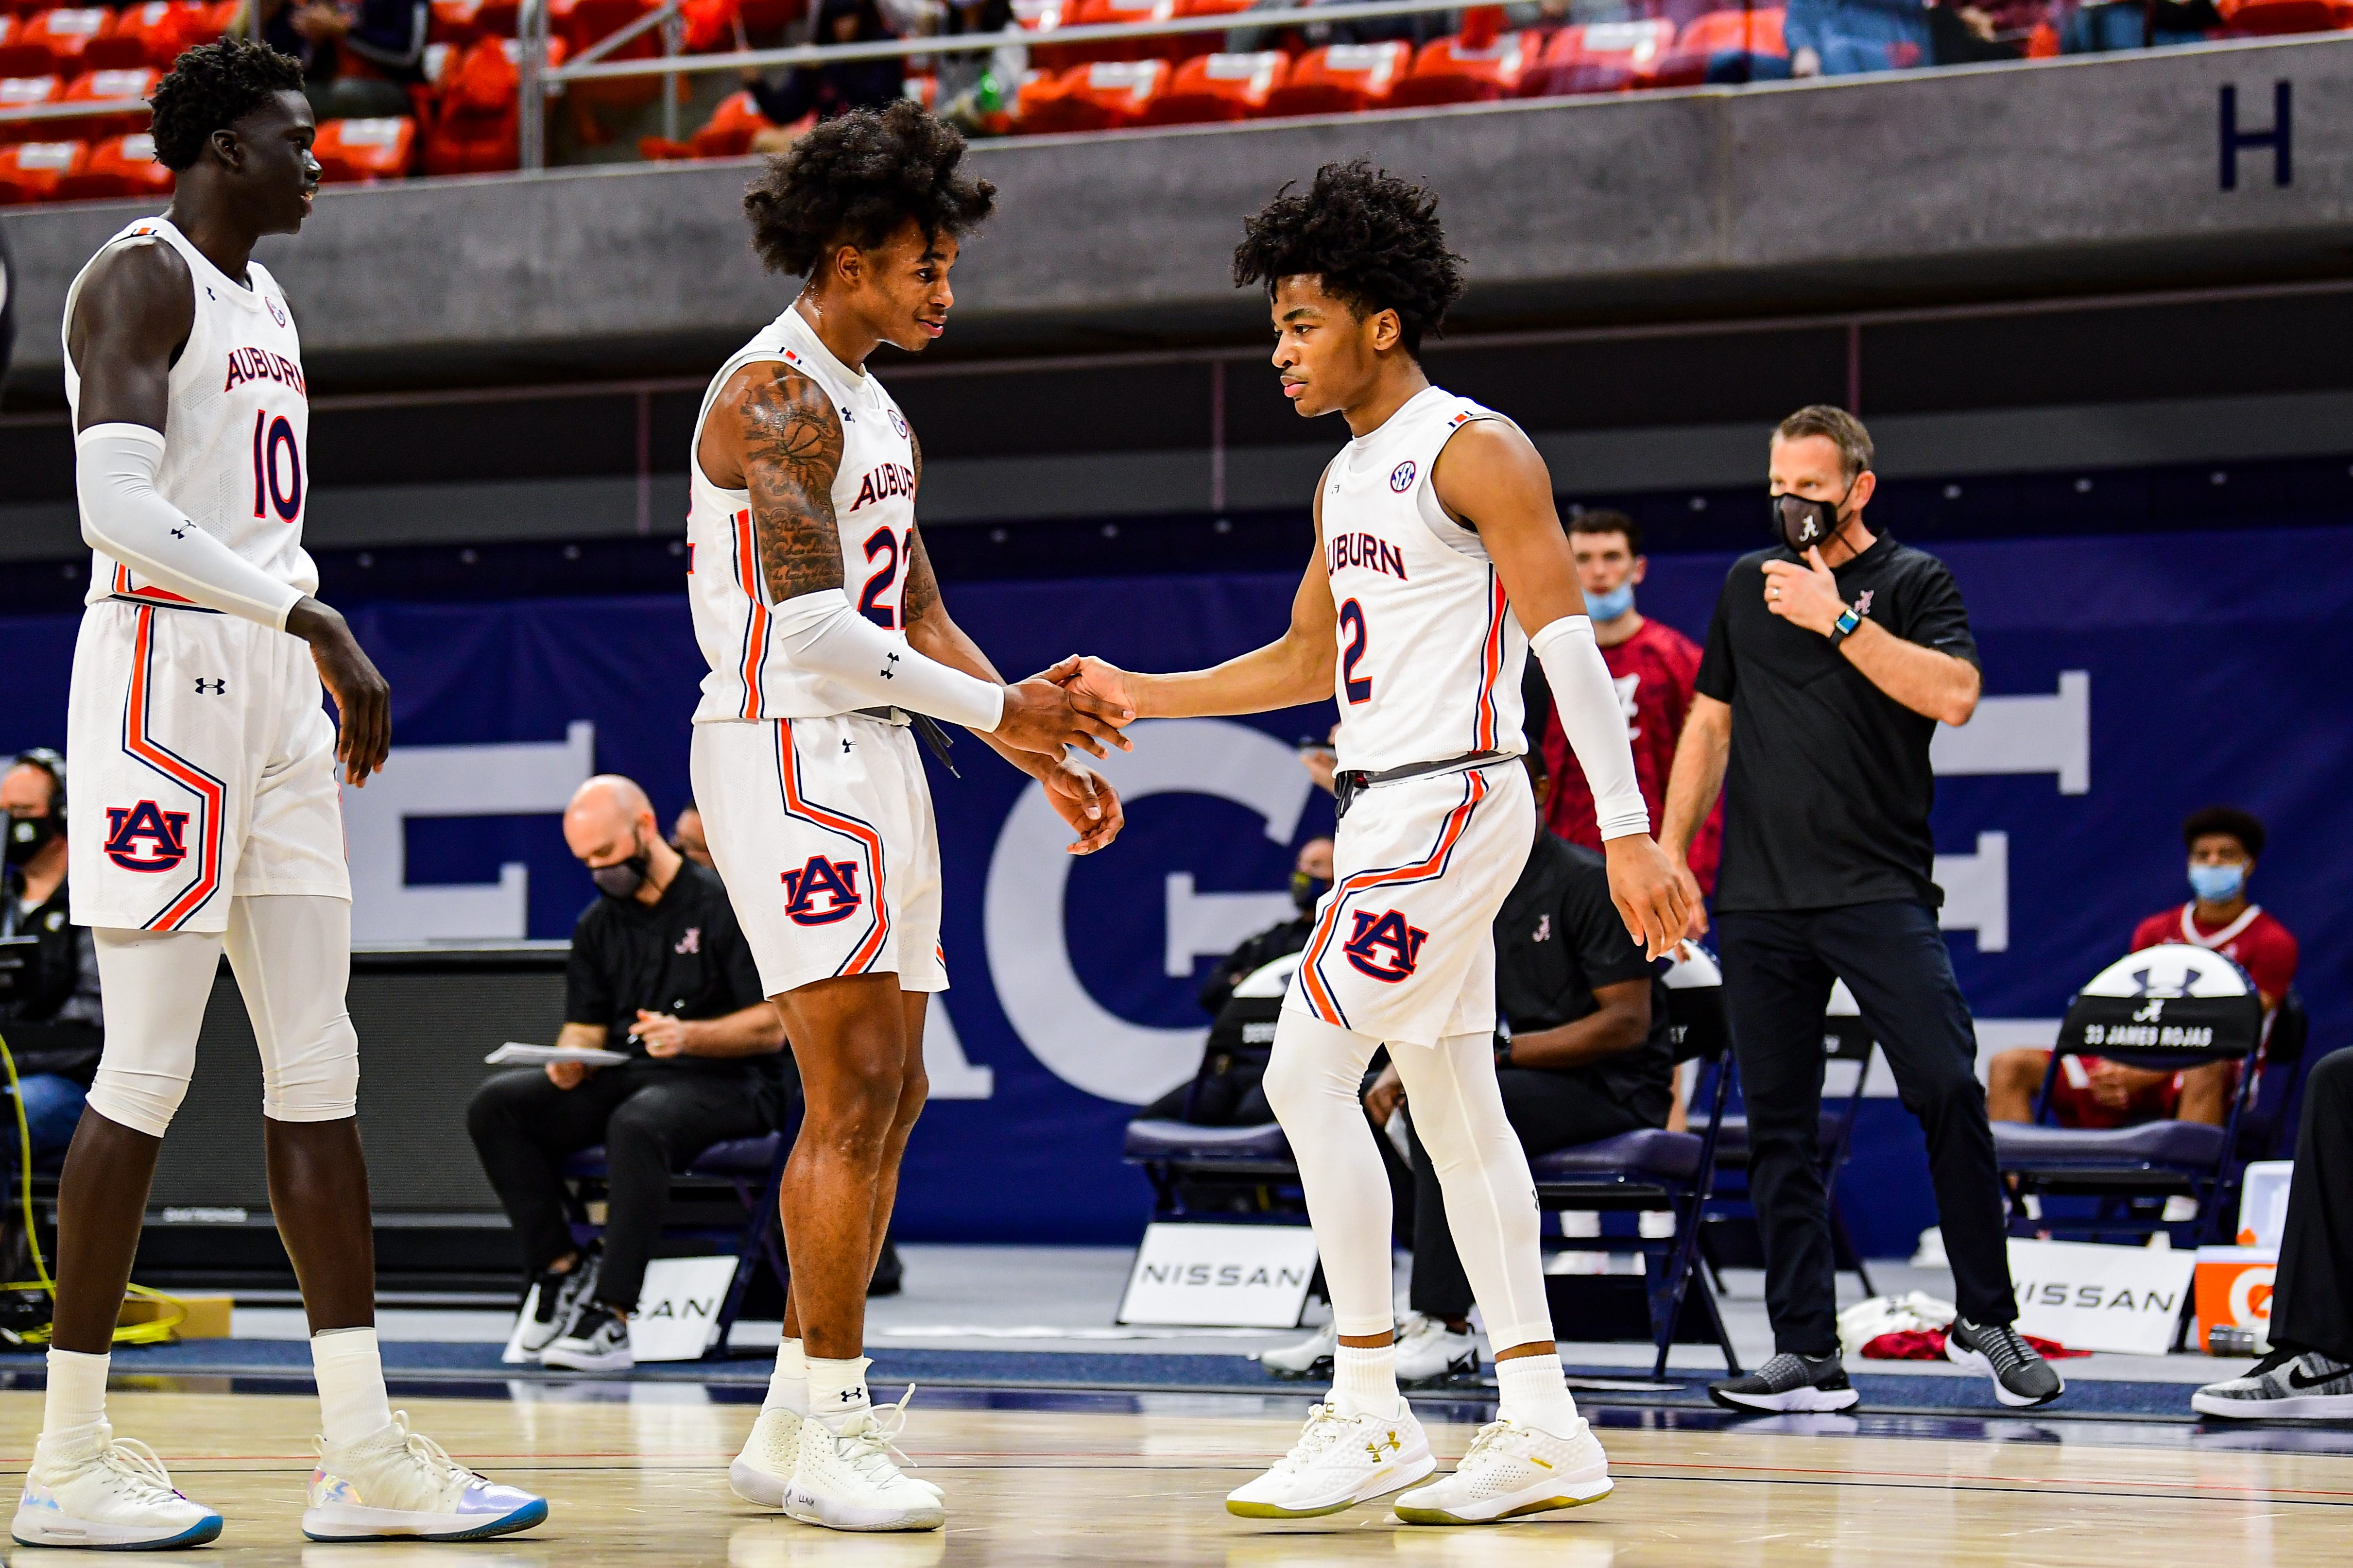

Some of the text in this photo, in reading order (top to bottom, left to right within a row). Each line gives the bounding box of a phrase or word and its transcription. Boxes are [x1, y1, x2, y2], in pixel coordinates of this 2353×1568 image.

[2219, 79, 2291, 191] H
[254, 409, 301, 523] 10
[850, 463, 916, 512] AUBUR
[1390, 460, 1415, 493] SEC
[1325, 532, 1408, 581] UBURN
[1340, 597, 1373, 706] 2
[2084, 1023, 2213, 1047] 33 JAMES ROJAS
[1140, 1263, 1305, 1290] NISSAN
[2014, 1281, 2175, 1314] ISSAN
